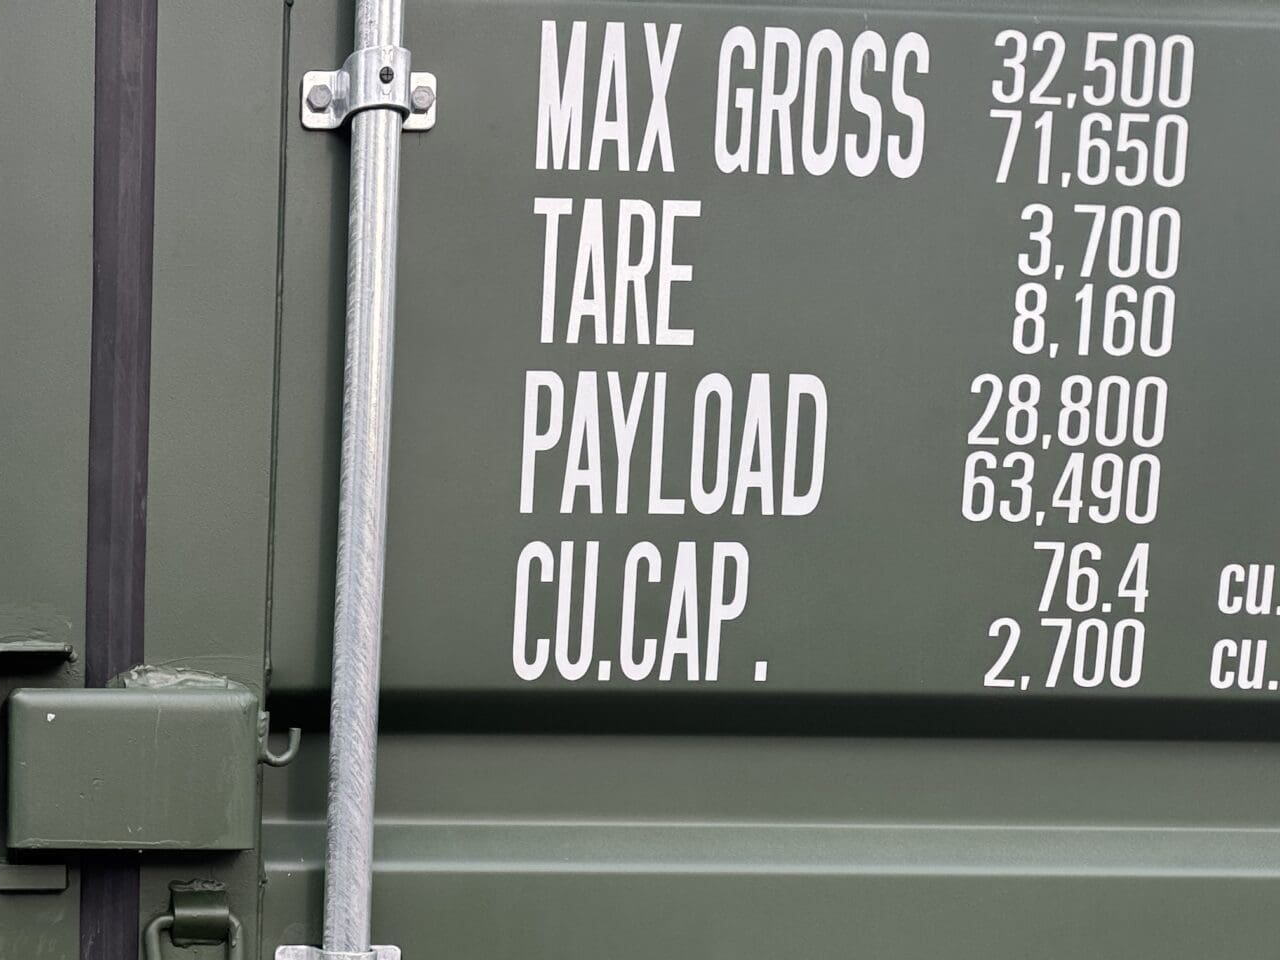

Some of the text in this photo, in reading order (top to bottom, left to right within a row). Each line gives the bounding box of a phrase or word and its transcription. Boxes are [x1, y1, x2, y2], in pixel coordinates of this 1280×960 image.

[534, 20, 930, 179] MAX GROSS
[991, 29, 1195, 109] 32,500
[989, 109, 1190, 188] 71,650
[533, 197, 702, 346] TARE
[1017, 203, 1182, 280] 3,700
[1012, 283, 1176, 359] 8,160
[520, 370, 828, 517] PAYLOAD
[967, 373, 1168, 449] 28,800
[960, 451, 1161, 526] 63,490
[1033, 541, 1150, 613] 76.4
[984, 618, 1146, 690] 2,700
